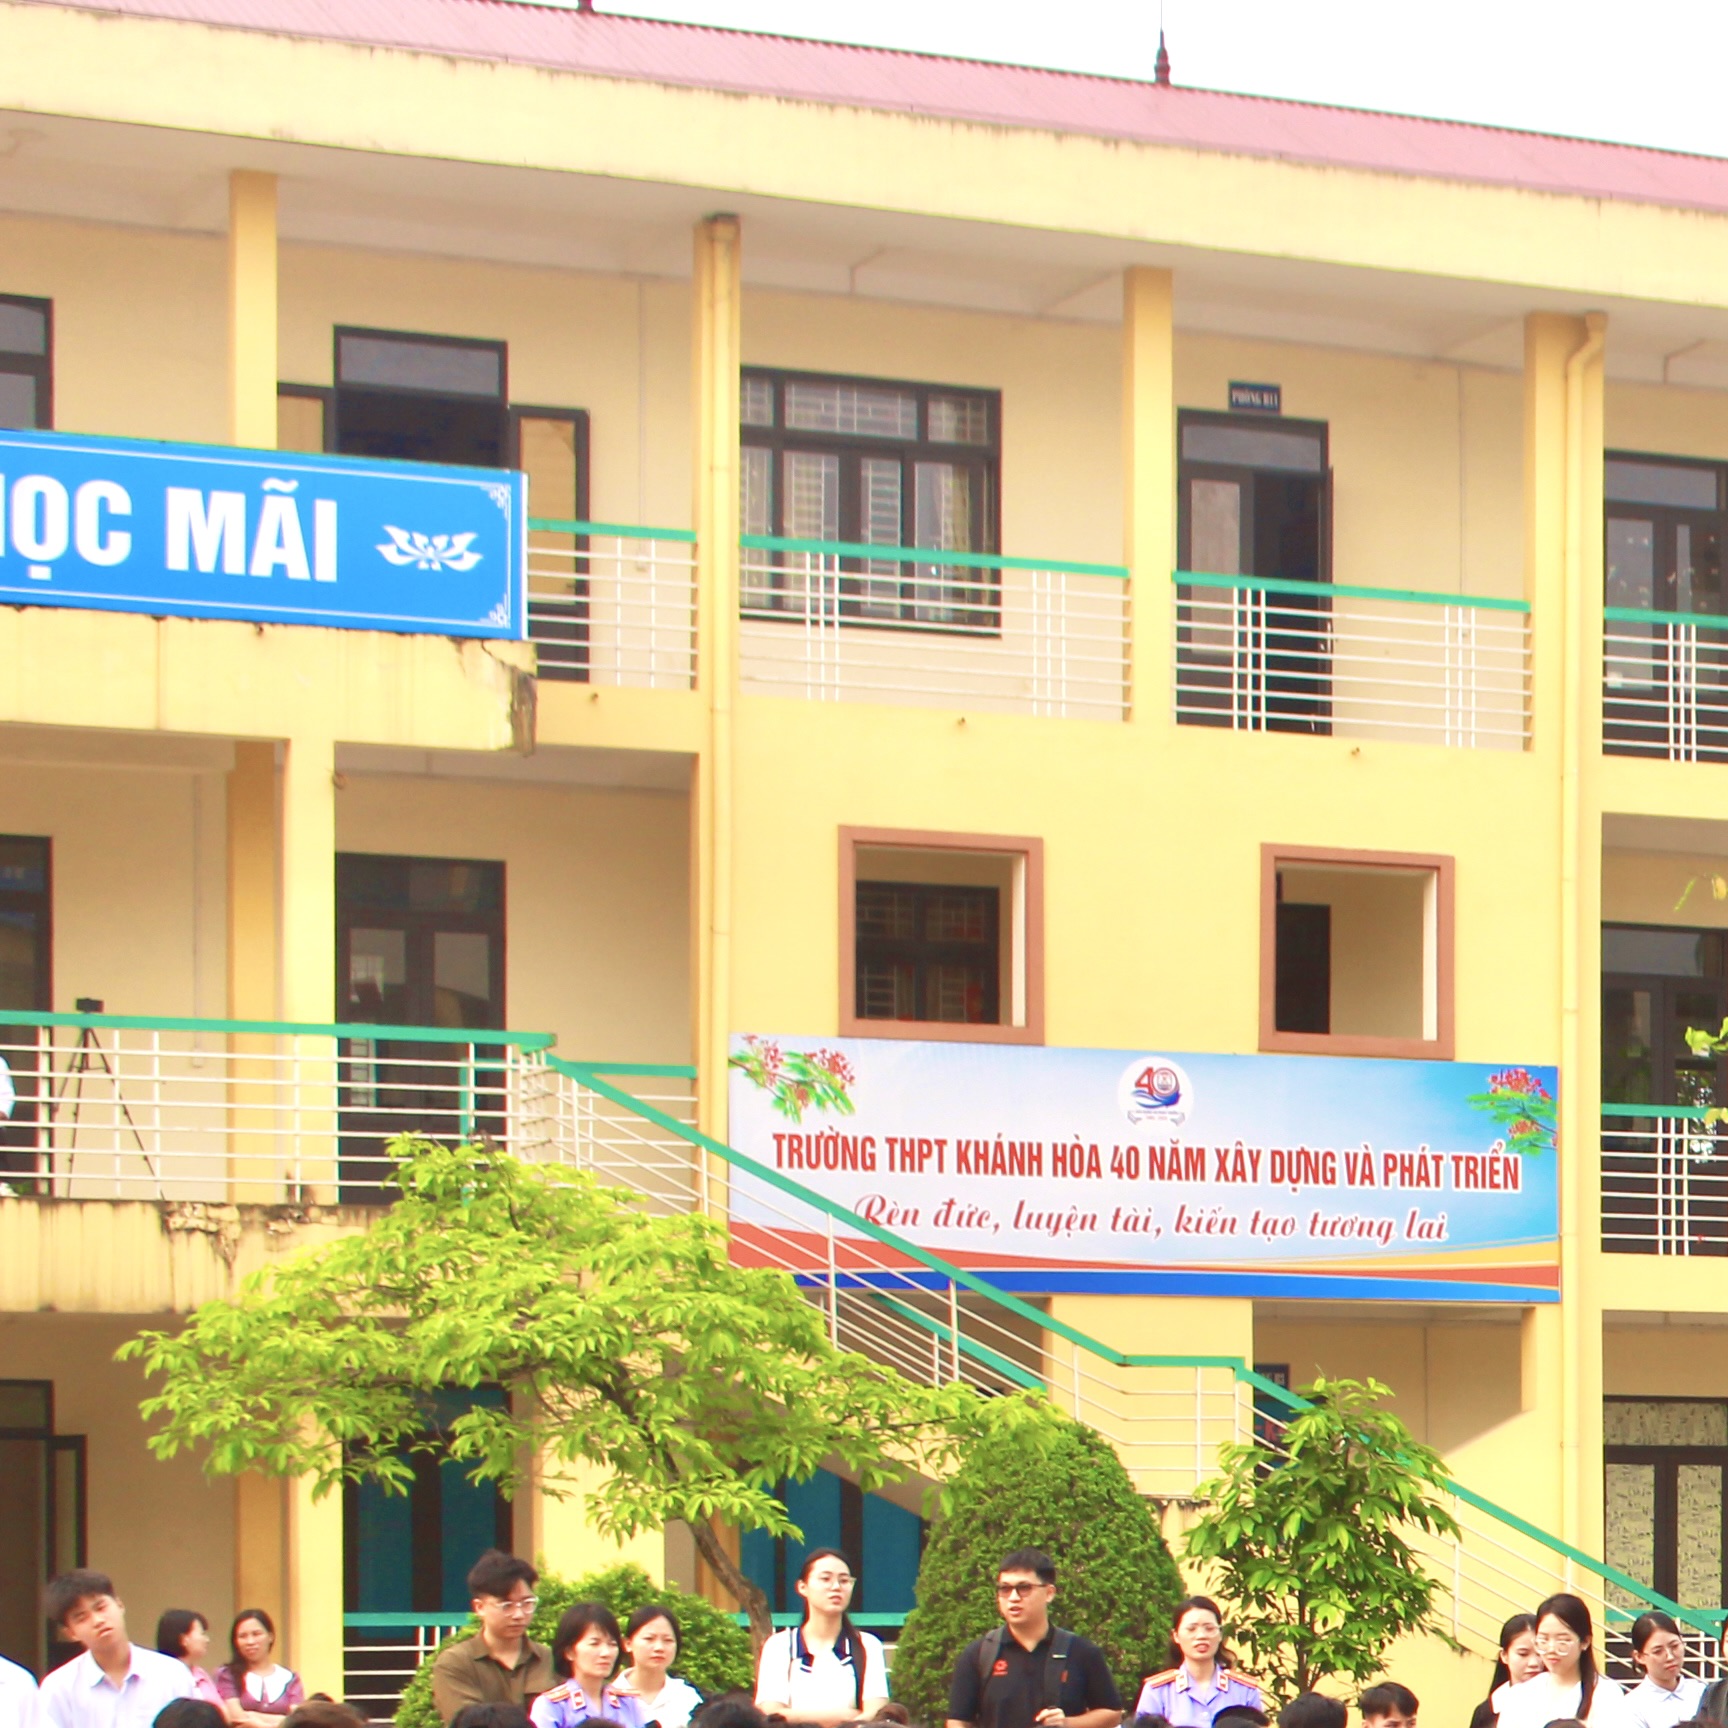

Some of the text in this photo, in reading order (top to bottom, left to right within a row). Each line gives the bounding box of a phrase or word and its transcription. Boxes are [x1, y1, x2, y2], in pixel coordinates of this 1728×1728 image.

[0, 474, 338, 582] ỌC MÃI
[772, 1126, 1520, 1192] TRƯỜNG THPT KHÁNH HÒA 40 NĂM XÂY DỰNG VÀ PHÁT TRIỂN
[854, 1193, 1448, 1246] Rèn đức, luyện tài, kiến tạo tương lai
